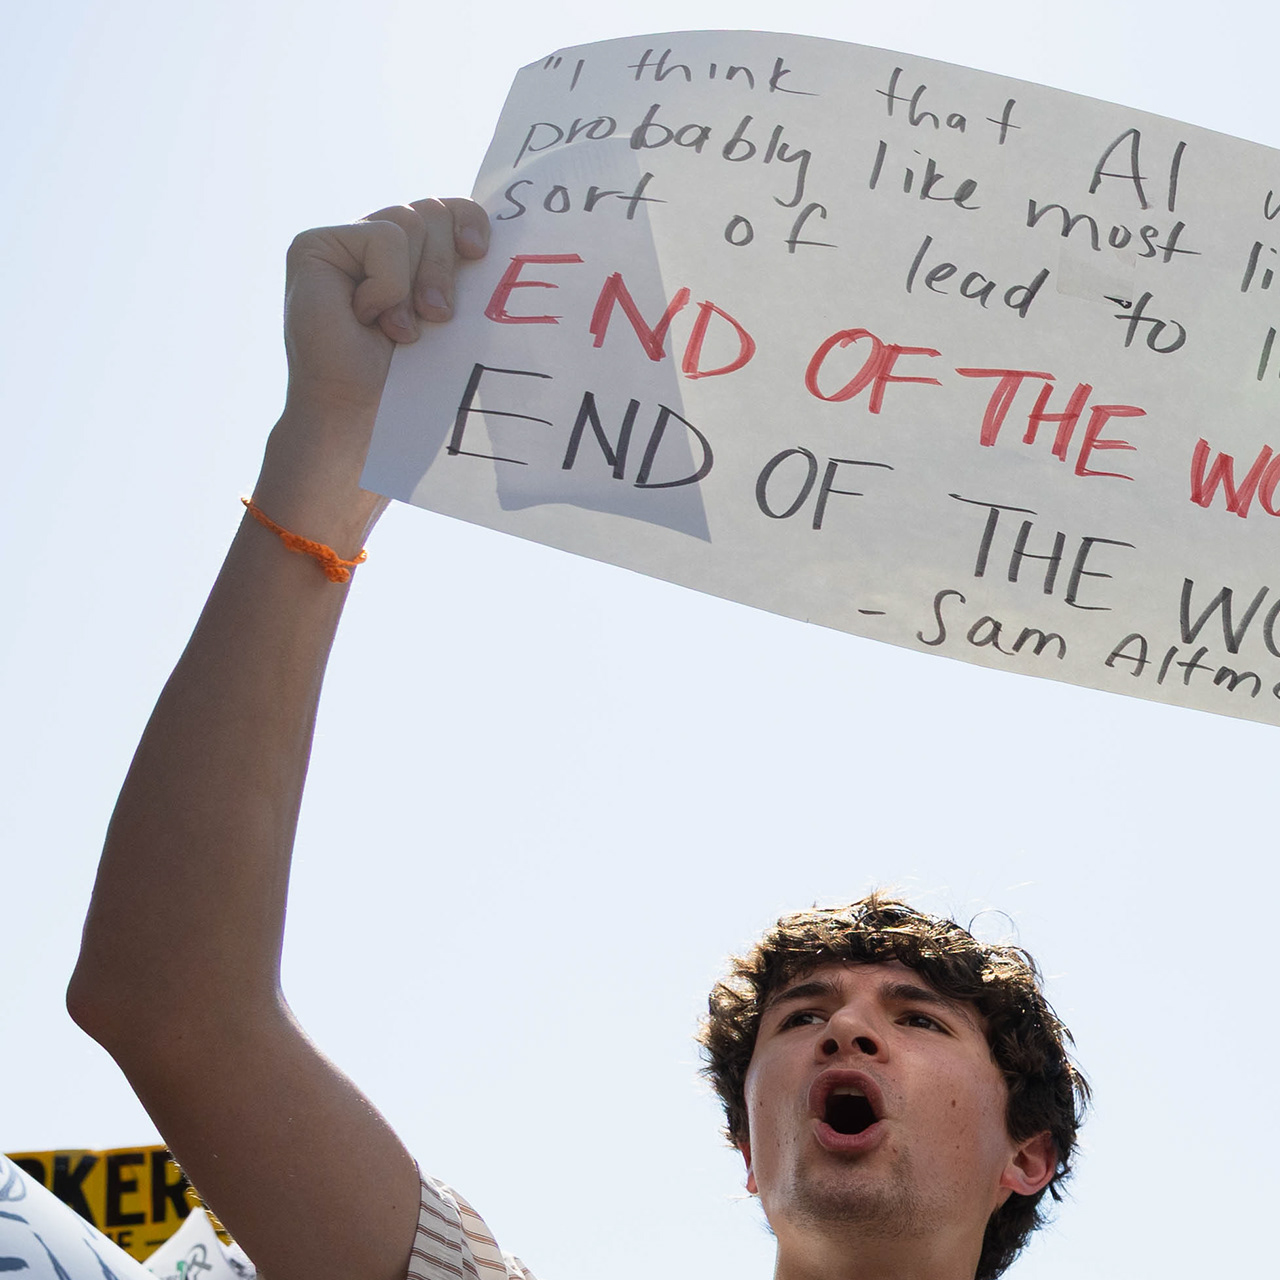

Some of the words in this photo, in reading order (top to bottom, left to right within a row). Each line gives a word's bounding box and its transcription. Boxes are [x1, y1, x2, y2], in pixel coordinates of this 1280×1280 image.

[627, 47, 821, 97] think
[875, 66, 1022, 145] that
[496, 171, 668, 221] sort
[722, 201, 839, 254] of
[904, 234, 1052, 319] lead
[1103, 291, 1188, 354] to
[512, 103, 813, 208] probably
[869, 139, 982, 211] like
[1026, 198, 1202, 264] most
[483, 253, 757, 380] END
[804, 328, 943, 415] OF
[954, 367, 1149, 481] THE
[446, 362, 715, 489] END
[755, 445, 896, 531] OF
[947, 493, 1137, 611] THE
[915, 589, 1067, 661] Sam
